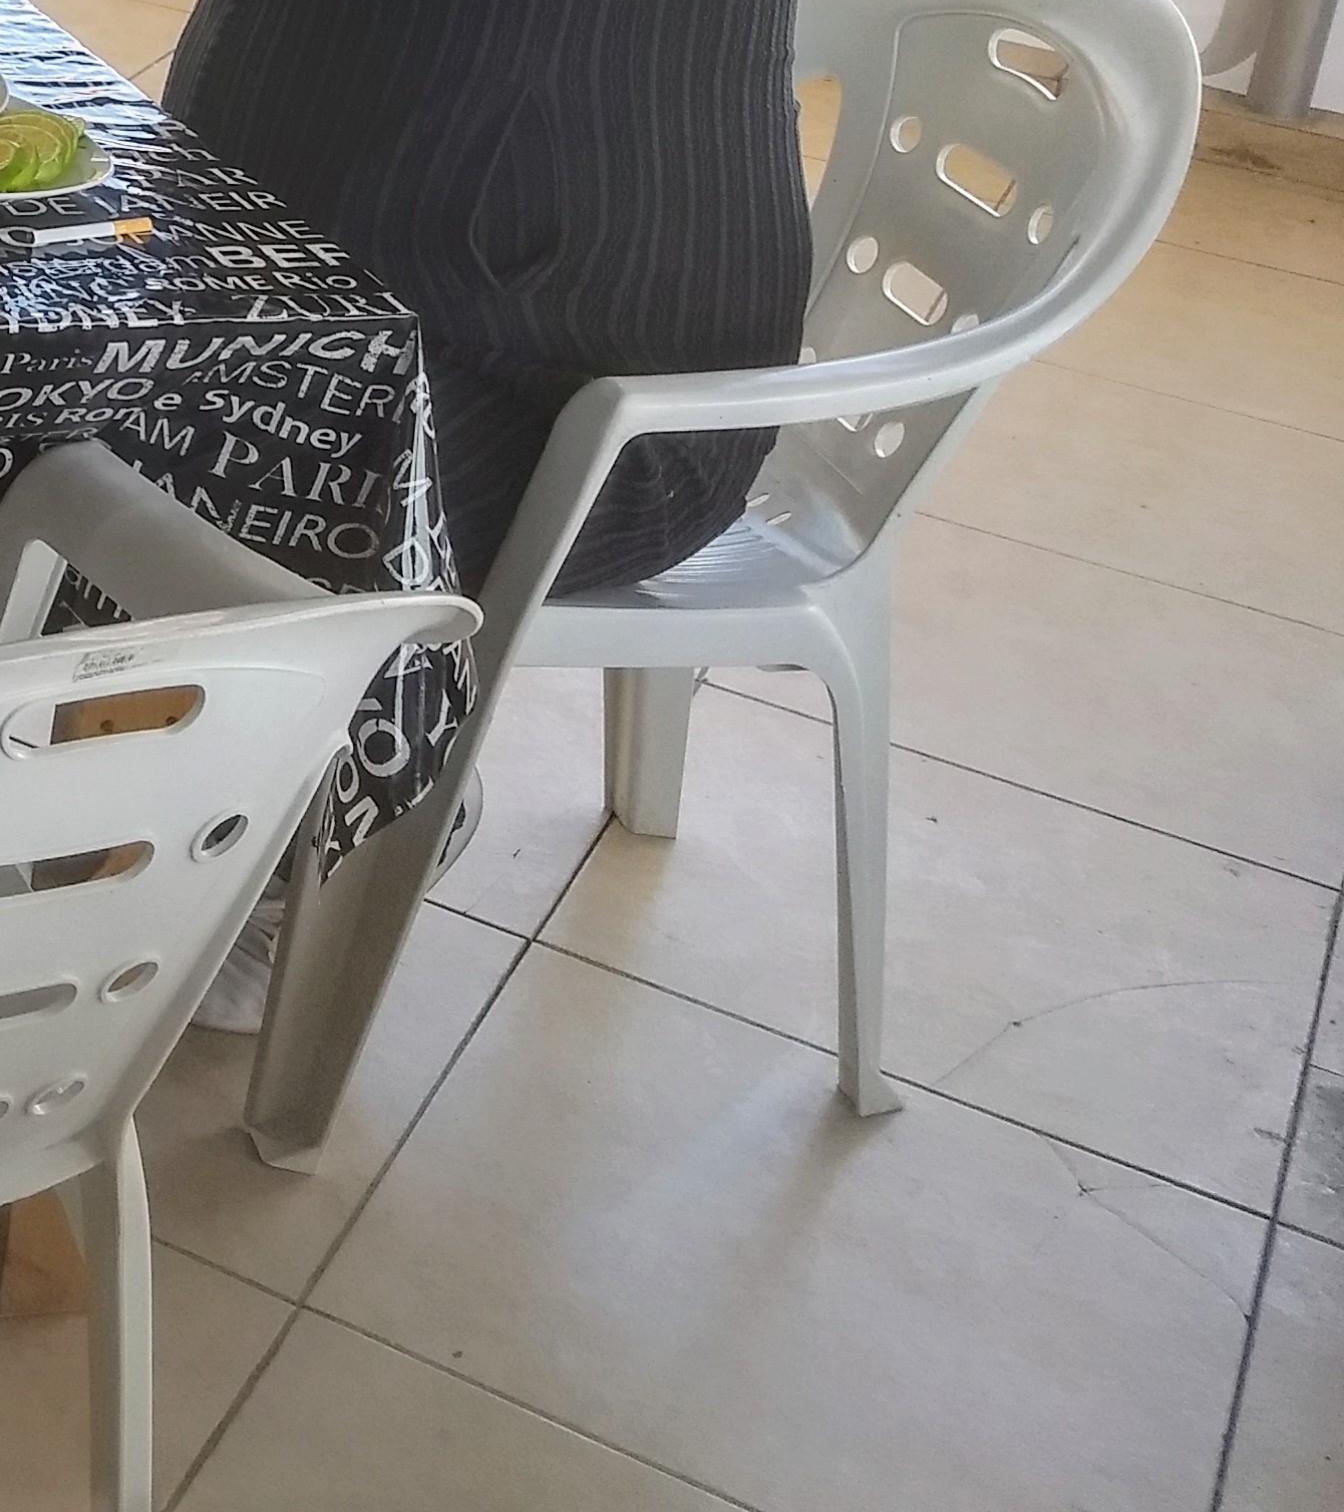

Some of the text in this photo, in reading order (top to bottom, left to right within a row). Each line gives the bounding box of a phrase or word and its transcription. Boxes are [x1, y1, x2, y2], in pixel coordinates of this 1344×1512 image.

[132, 166, 259, 188] PAR
[229, 289, 415, 322] ZURI
[0, 349, 94, 375] Paris
[92, 330, 417, 376] MUNICH
[208, 431, 383, 508] PARI
